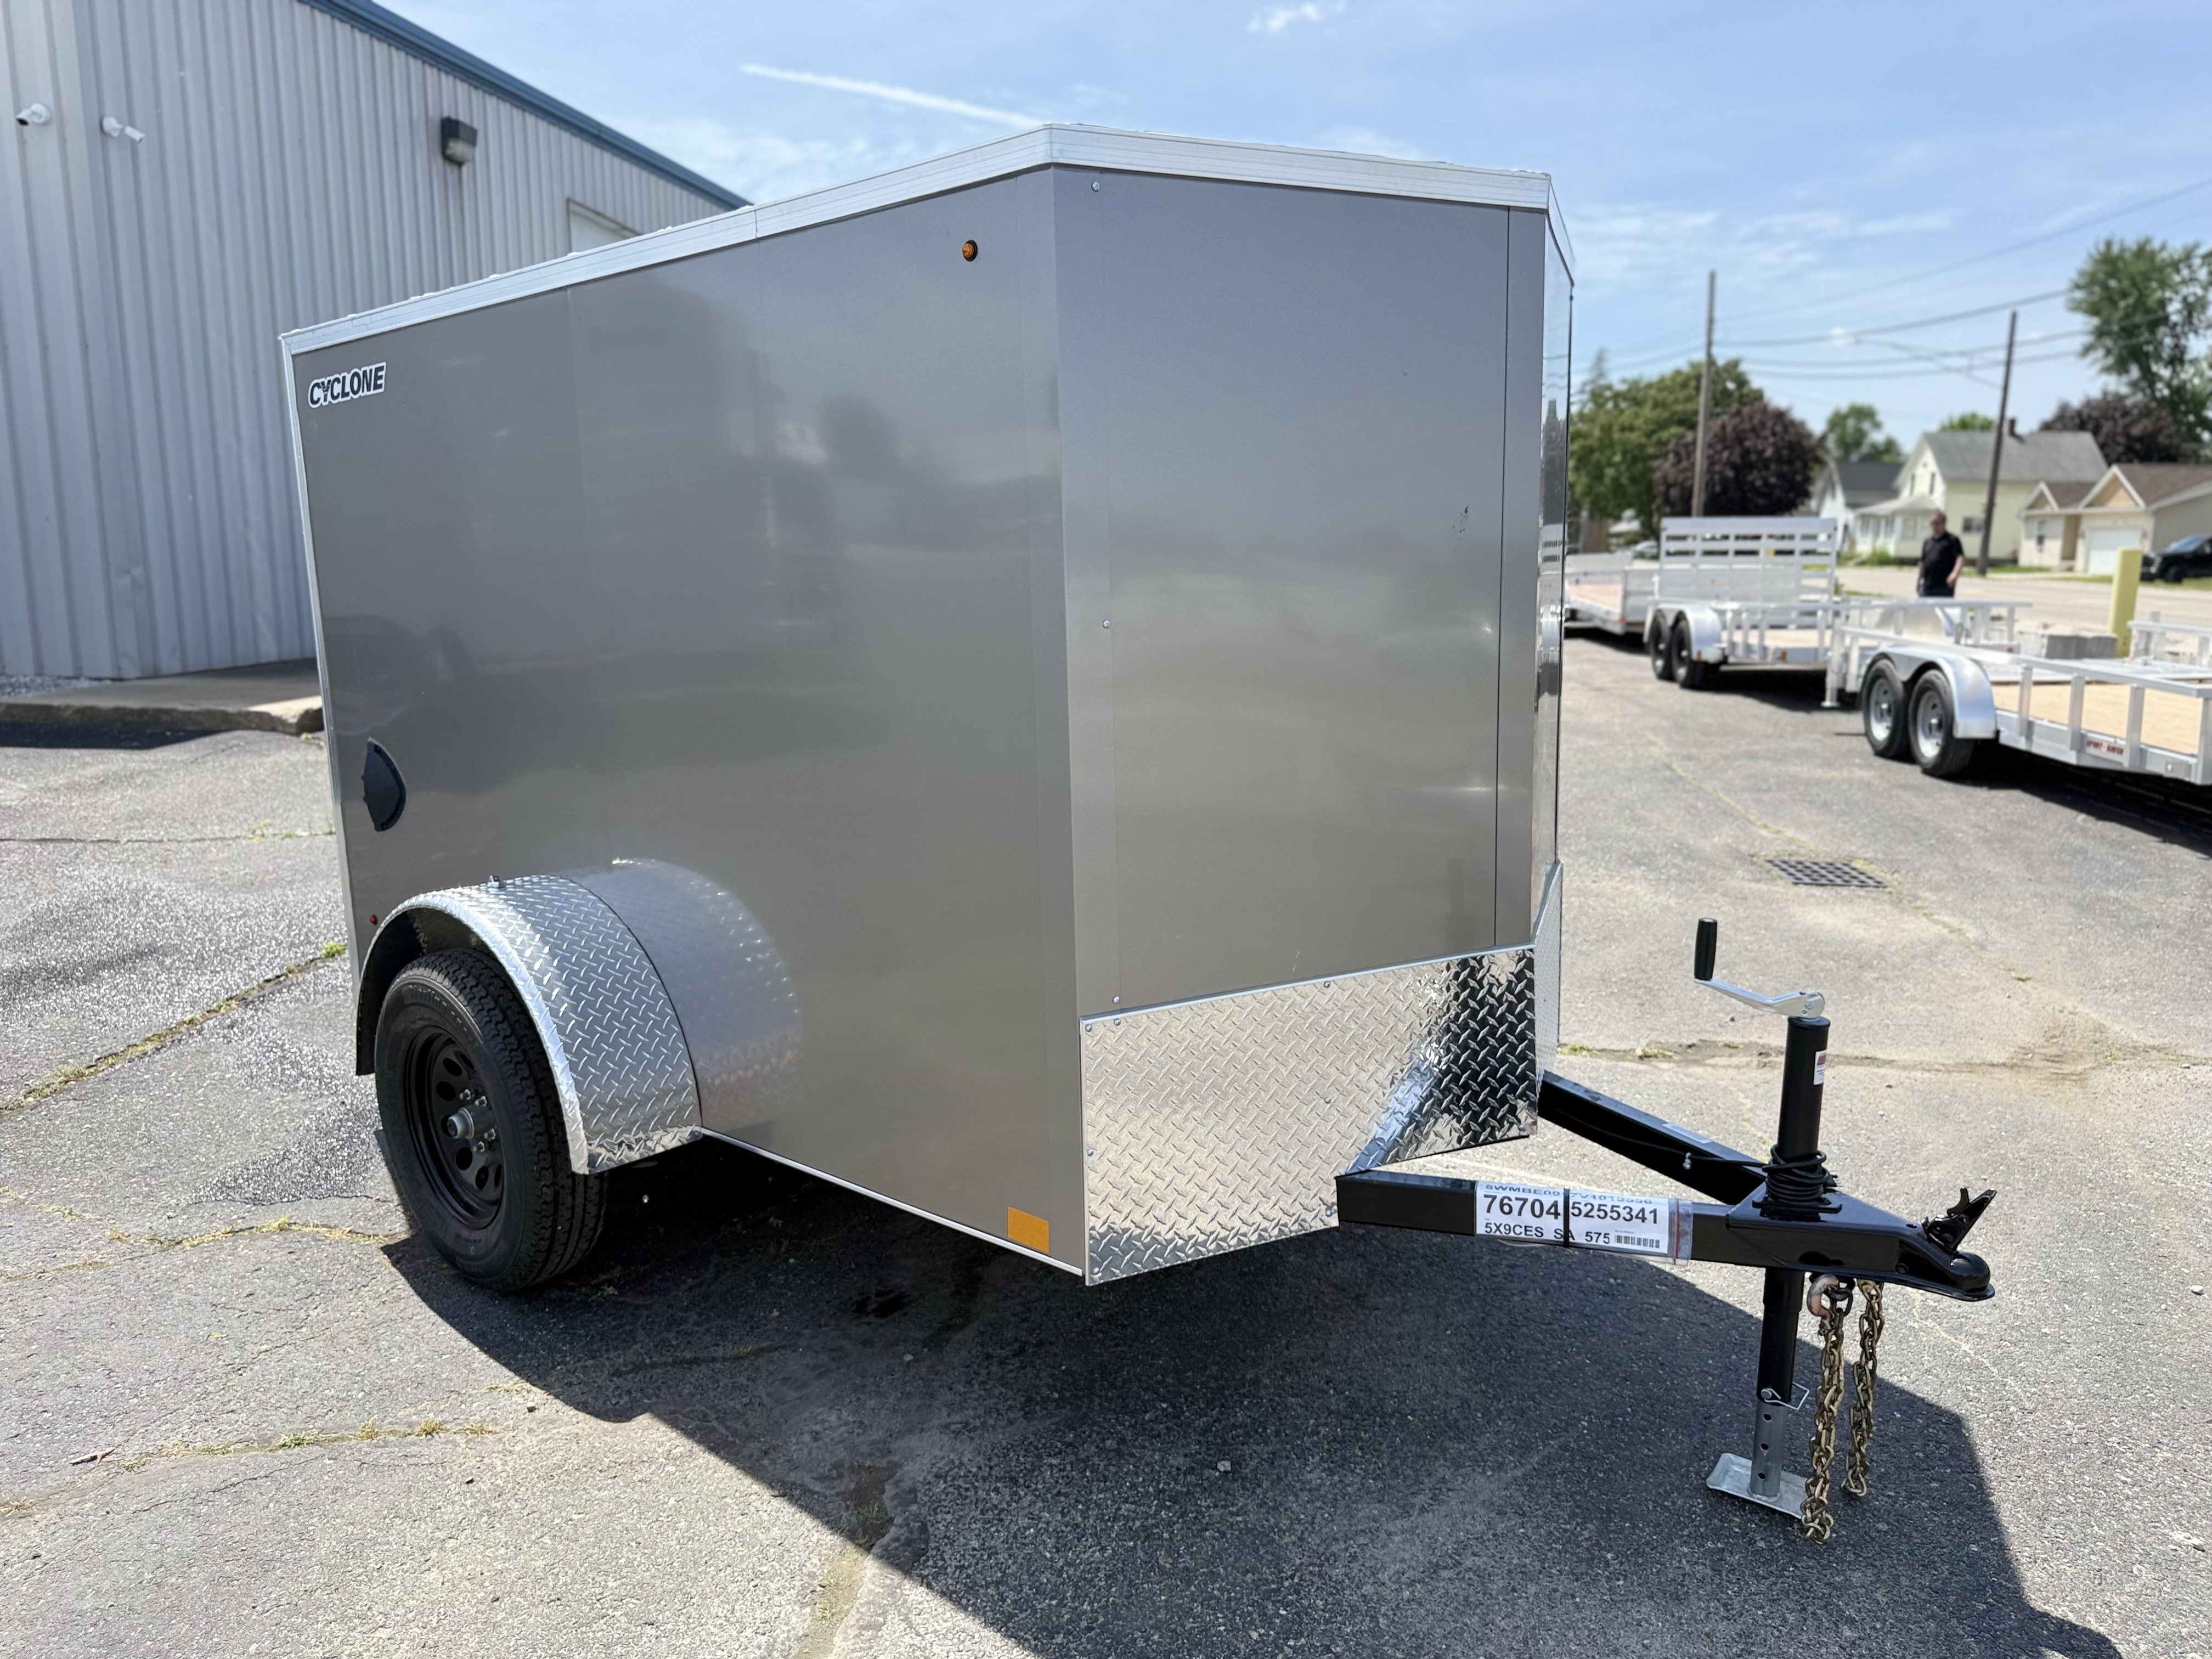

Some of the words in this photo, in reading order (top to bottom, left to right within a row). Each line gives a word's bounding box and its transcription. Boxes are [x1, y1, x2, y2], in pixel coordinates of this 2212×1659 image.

[309, 365, 385, 405] CYCLONE
[1483, 1194, 1561, 1220] 76704
[1571, 1201, 1657, 1224] 5255341
[1485, 1222, 1544, 1238] 5X9CES
[1585, 1231, 1610, 1244] 575
